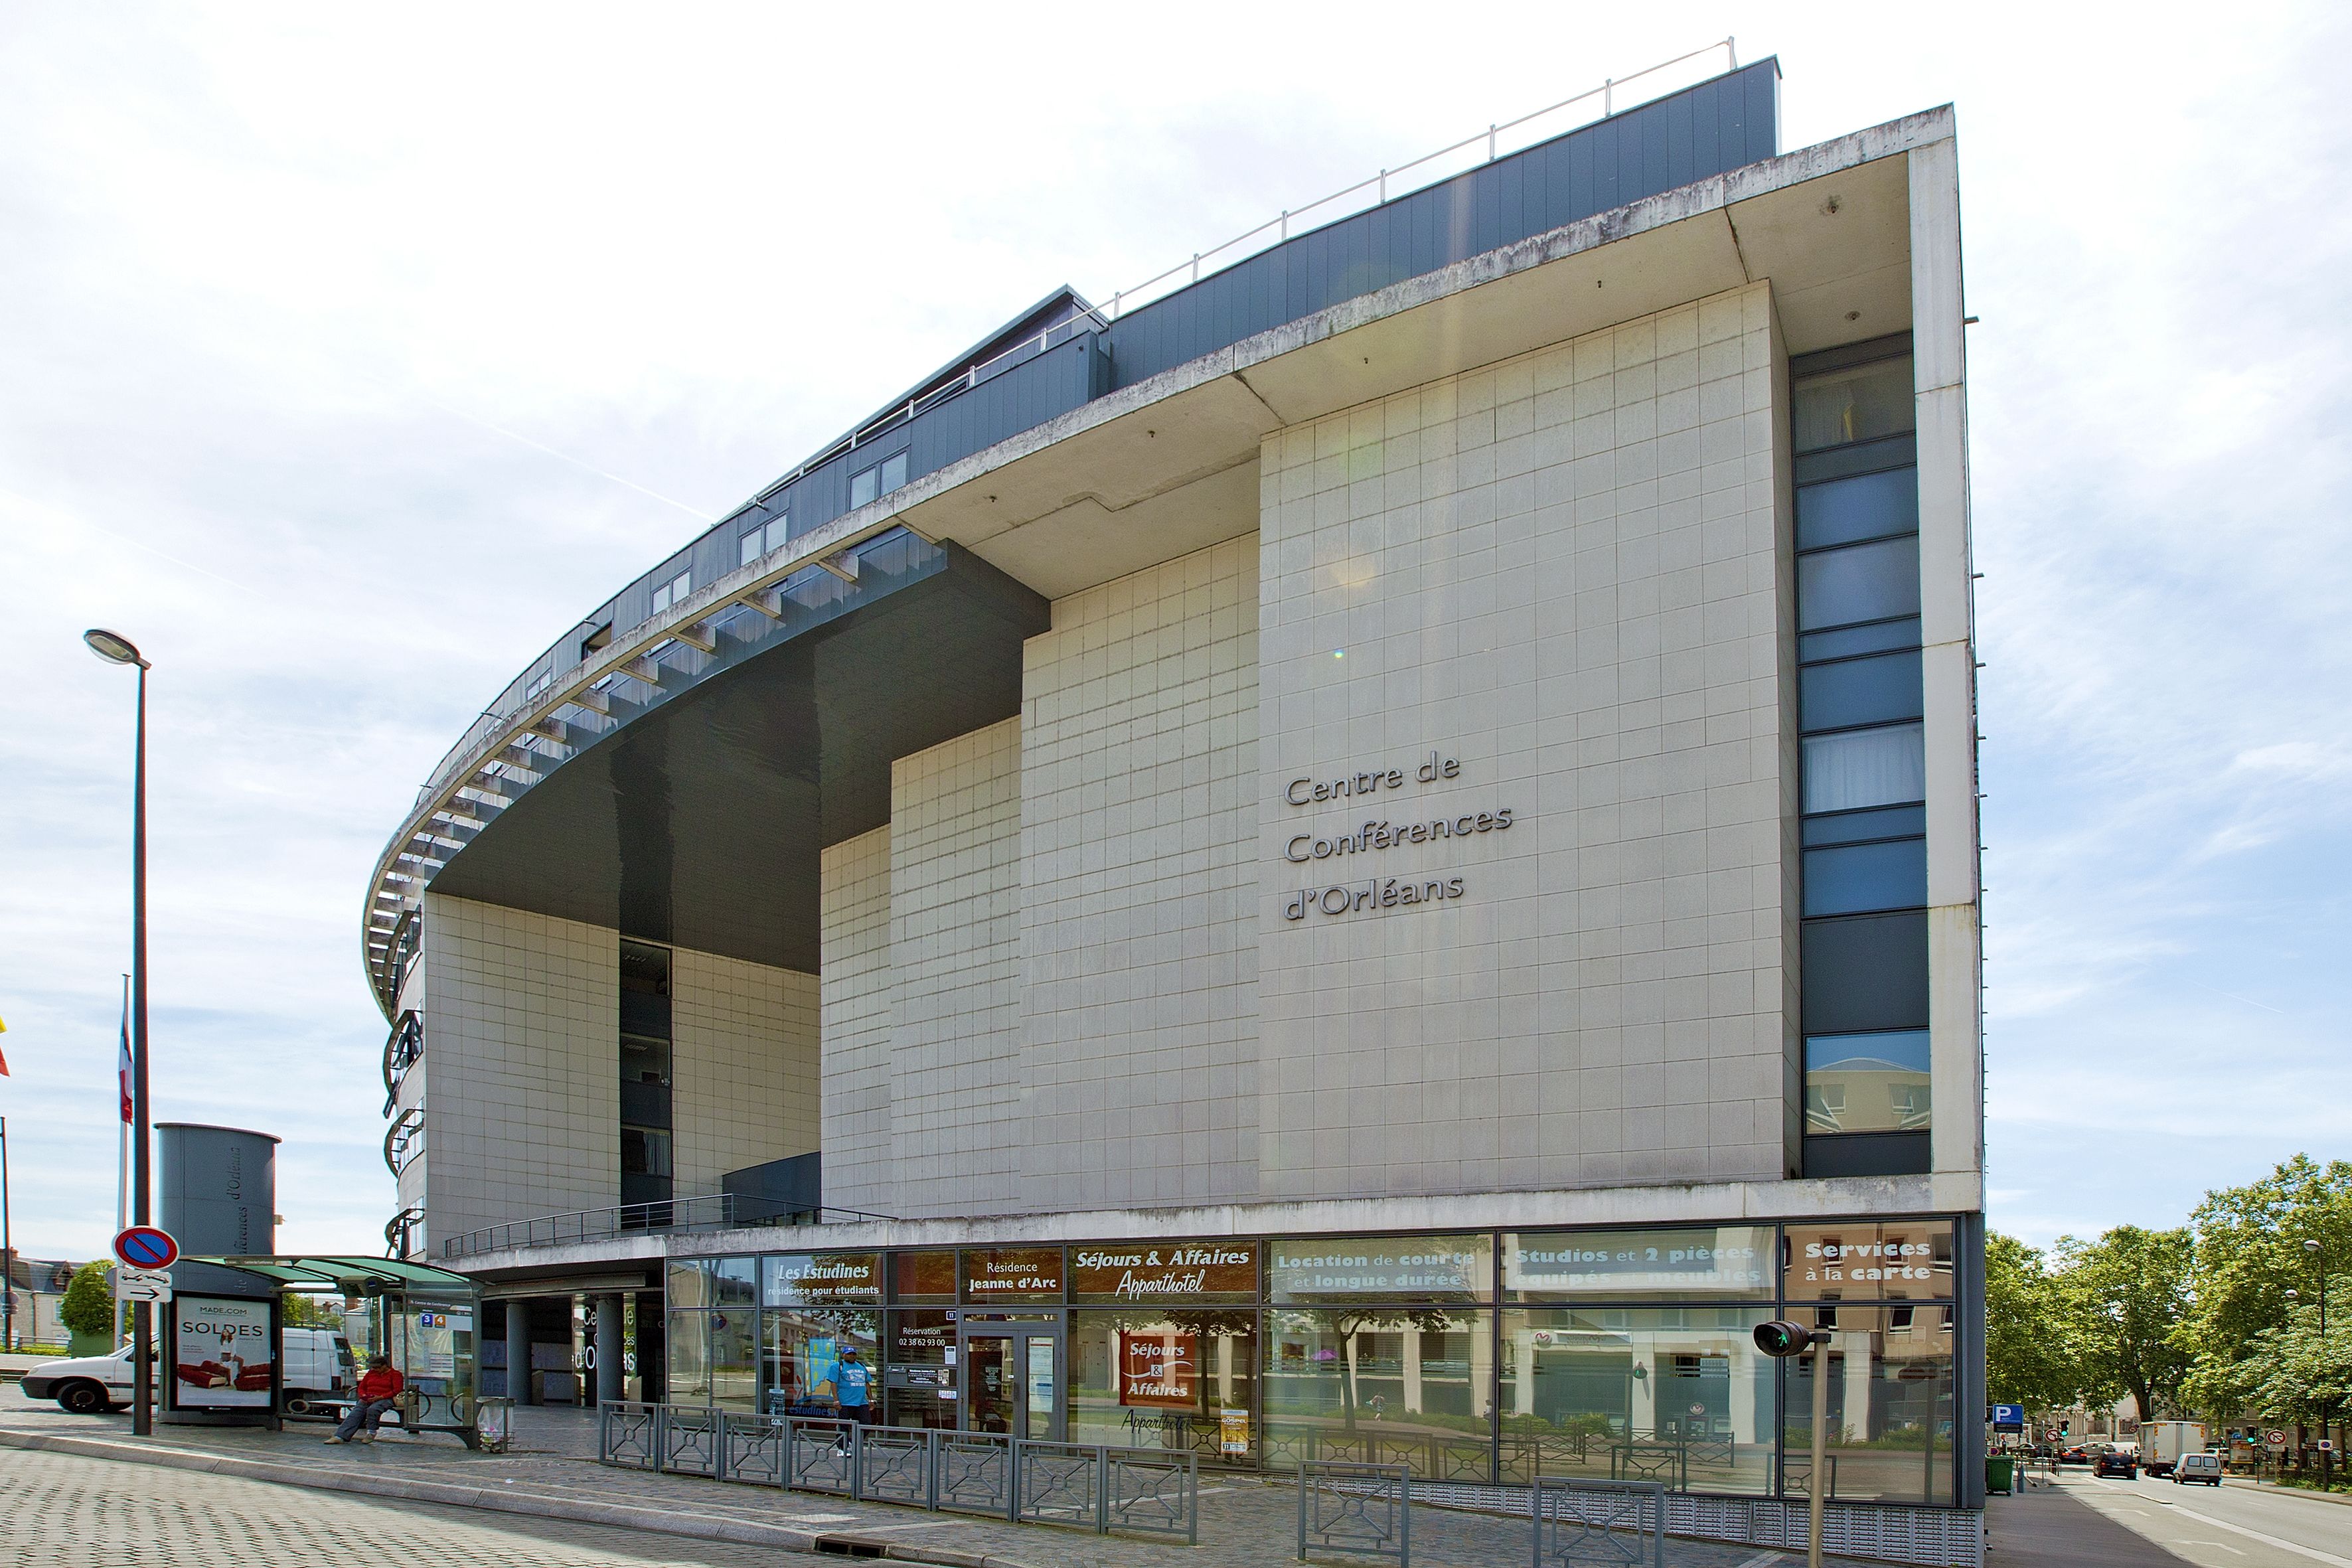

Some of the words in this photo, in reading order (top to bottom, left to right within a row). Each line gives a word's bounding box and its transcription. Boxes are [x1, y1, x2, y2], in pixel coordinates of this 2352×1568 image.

[1284, 767, 1403, 805] Centre
[1415, 750, 1460, 783] de
[1284, 807, 1513, 862] Conférences
[1515, 1248, 1609, 1263] Studios
[1616, 1250, 1636, 1261] et
[1645, 1247, 1659, 1261] 2
[1669, 1245, 1755, 1264] pièces
[1805, 1240, 1931, 1258] Services
[986, 1262, 1038, 1273] Résidence
[1076, 1251, 1142, 1271] Séjours
[1146, 1251, 1162, 1266] &
[1168, 1249, 1249, 1265] Affaires
[1278, 1254, 1368, 1268] Location
[1373, 1254, 1393, 1266] de
[1399, 1252, 1475, 1265] courte
[778, 1264, 801, 1280] Les
[803, 1263, 869, 1279] Estudines
[1514, 1271, 1611, 1287] équipés
[1647, 1268, 1761, 1283] meublés
[1805, 1267, 1818, 1281] à
[1825, 1267, 1843, 1281] la
[1850, 1265, 1931, 1281] carte
[969, 1279, 1014, 1293] Jeanne
[1115, 1269, 1206, 1300] Apparthotel
[1294, 1277, 1310, 1287] et
[1315, 1275, 1387, 1289] longue
[1395, 1273, 1462, 1287] durée
[767, 1287, 810, 1295] résidence
[812, 1287, 832, 1296] pour
[834, 1285, 880, 1295] étudiants
[200, 1306, 247, 1315] MADE.COM
[183, 1322, 263, 1336] SOLDES
[1130, 1343, 1185, 1359] Séjours
[1153, 1366, 1161, 1375] &
[1128, 1382, 1188, 1397] Affaires
[1121, 1409, 1193, 1434] Apparthotel
[1996, 1406, 2011, 1422] P
